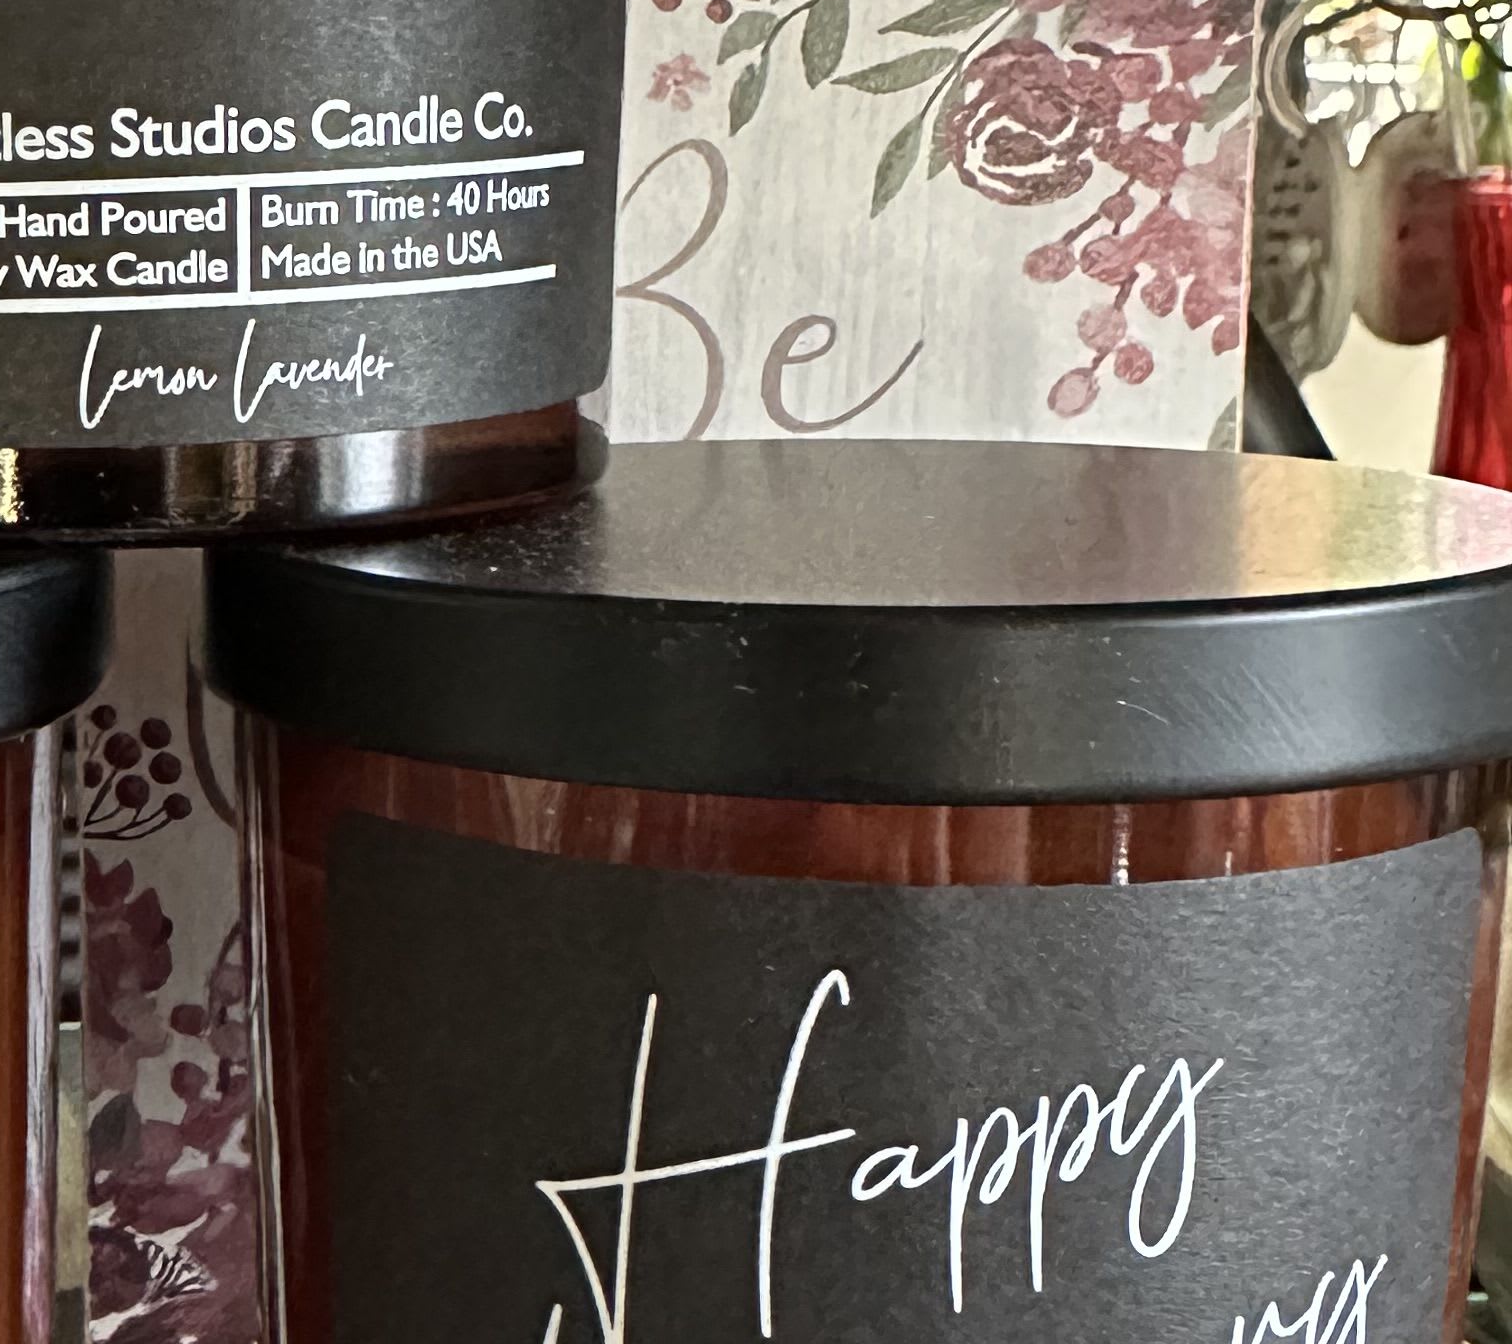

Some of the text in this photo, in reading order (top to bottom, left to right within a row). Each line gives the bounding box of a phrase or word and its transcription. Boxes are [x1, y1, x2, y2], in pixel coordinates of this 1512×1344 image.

[110, 103, 297, 158] Studios
[311, 94, 464, 150] Candle
[473, 91, 533, 140] Co.
[101, 196, 226, 236] Poured
[261, 194, 339, 228] Burn
[346, 188, 425, 224] Time
[446, 180, 481, 216] 40
[486, 177, 550, 213] Hours
[14, 254, 98, 289] Wax
[106, 249, 229, 286] Candle
[261, 229, 503, 280] Made in the USA
[616, 138, 923, 441] Be
[79, 318, 395, 430] Lemon Lavender
